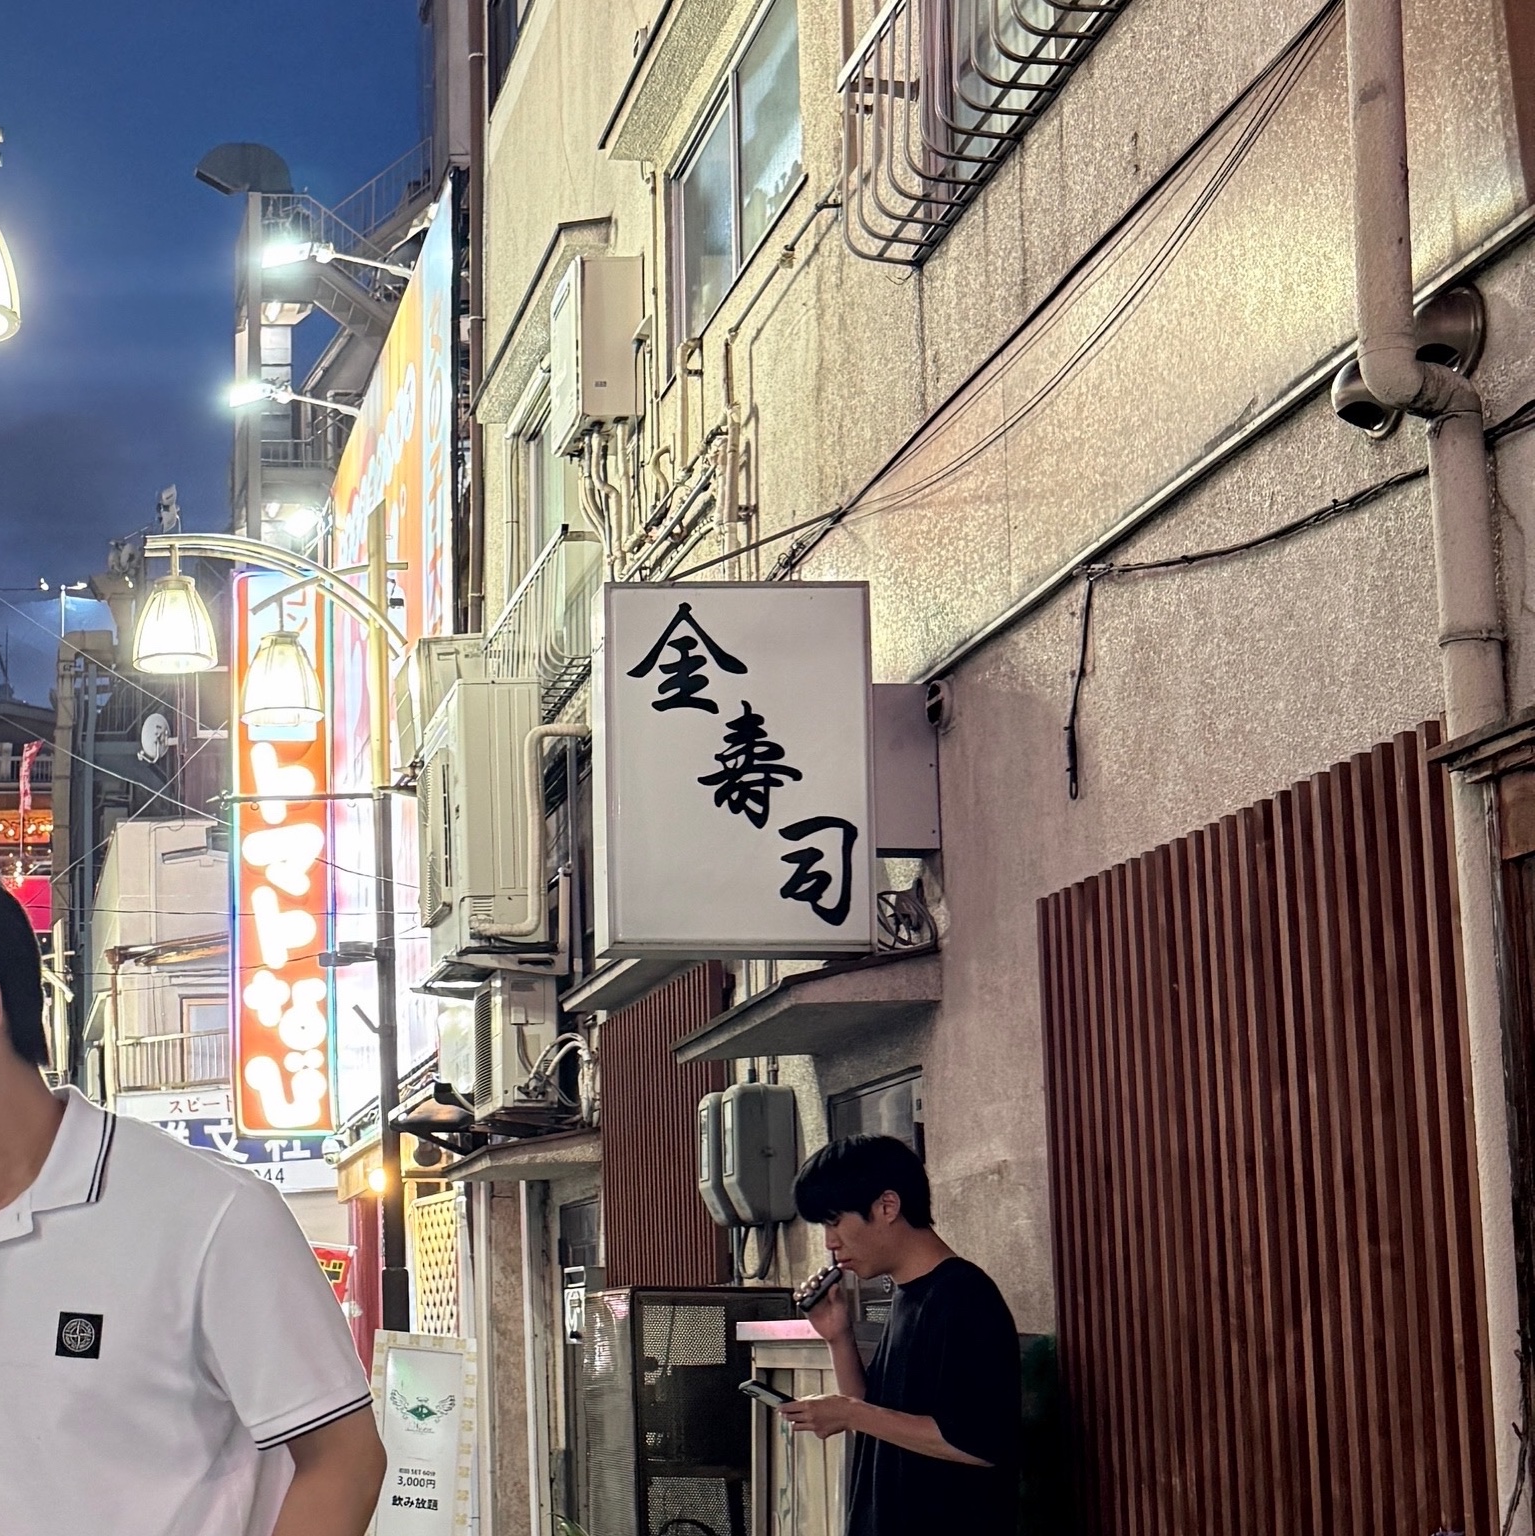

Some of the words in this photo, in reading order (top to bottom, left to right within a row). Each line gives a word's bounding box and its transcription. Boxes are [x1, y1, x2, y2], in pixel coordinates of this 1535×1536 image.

[397, 1476, 436, 1489] 3,000円
[391, 1495, 439, 1511] 飲み放題
